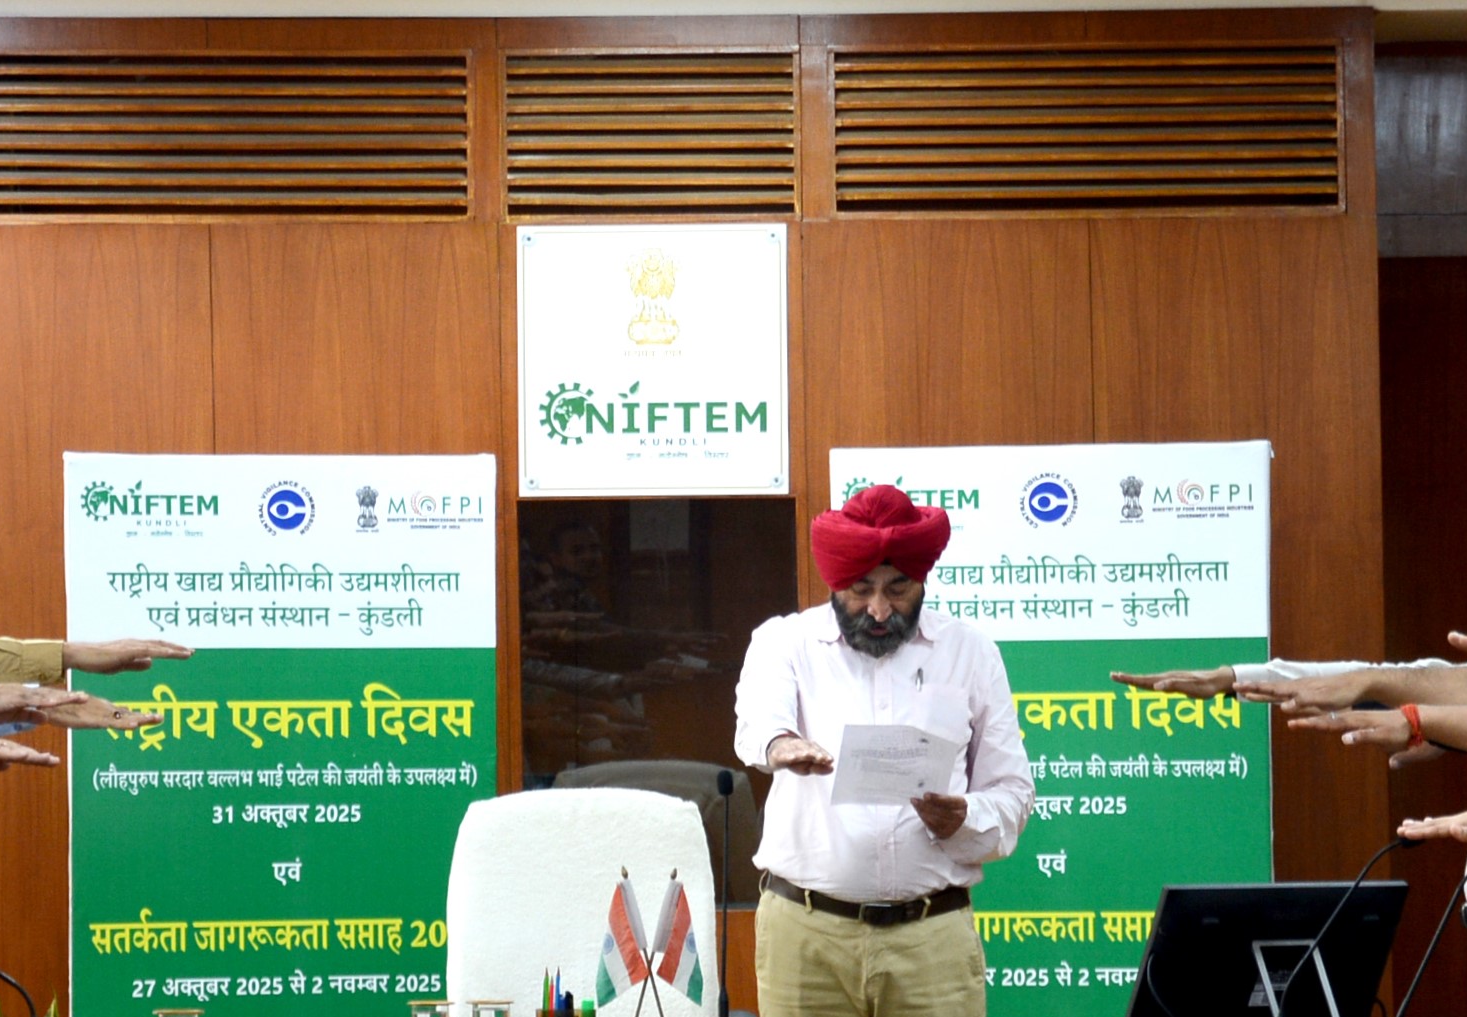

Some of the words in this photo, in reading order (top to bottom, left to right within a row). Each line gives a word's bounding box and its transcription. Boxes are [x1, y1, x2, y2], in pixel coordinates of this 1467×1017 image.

[586, 402, 768, 434] NIFTEM
[639, 437, 708, 447] KUNDLI
[109, 494, 219, 516] NIFTEM
[136, 519, 187, 527] KUNDLI
[107, 563, 169, 597] राष्ट्रीय
[175, 573, 223, 591] खाद्य
[229, 562, 333, 591] प्रौद्योगिकी
[339, 564, 460, 592] उद्यमशीलता
[937, 567, 984, 585] खाद्य
[991, 555, 1096, 584] प्रौद्योगिकी
[1103, 553, 1228, 583] उद्यमशीलता
[147, 601, 180, 631] एवं
[186, 602, 253, 626] प्रबंधन
[259, 601, 330, 626] संस्थान
[358, 598, 423, 636] कुंडली
[949, 594, 1014, 619] प्रबंधन
[1021, 594, 1092, 618] संस्थान
[1121, 588, 1189, 626] कुंडली
[227, 701, 352, 748] एकता
[361, 683, 474, 744] दिवस
[162, 771, 204, 789] सरदार
[207, 771, 253, 786] वल्लभ
[257, 764, 283, 786] भाई
[286, 764, 318, 785] पटेल
[322, 763, 341, 785] की
[345, 763, 383, 784] जयंती
[387, 763, 400, 784] के
[404, 769, 456, 784] उपलक्ष्य
[1049, 755, 1083, 777] पटेल
[1086, 754, 1106, 777] की
[1109, 754, 1149, 777] जयंती
[1152, 754, 1167, 776] के
[1171, 760, 1225, 778] उपलक्ष्य
[213, 806, 233, 823] 31
[242, 805, 309, 827] अक्तूबर
[315, 805, 360, 822] 2025
[1080, 797, 1126, 814] 2025
[273, 858, 301, 885] एवं
[1037, 850, 1066, 877] एवं
[90, 909, 187, 953] सतर्कता
[194, 920, 328, 950] जागरूकता
[335, 919, 402, 952] सप्ताह
[412, 921, 448, 946] 20
[974, 912, 1095, 943] ागरूकता
[133, 980, 155, 997] 27
[163, 978, 230, 1001] अक्तूबर
[237, 978, 282, 995] 2025
[289, 970, 306, 993] से
[312, 977, 322, 993] 2
[329, 975, 389, 992] नवम्बर
[396, 976, 441, 993] 2025
[1002, 969, 1048, 986] 2025
[1055, 962, 1072, 985] से
[1079, 969, 1089, 985] 2
